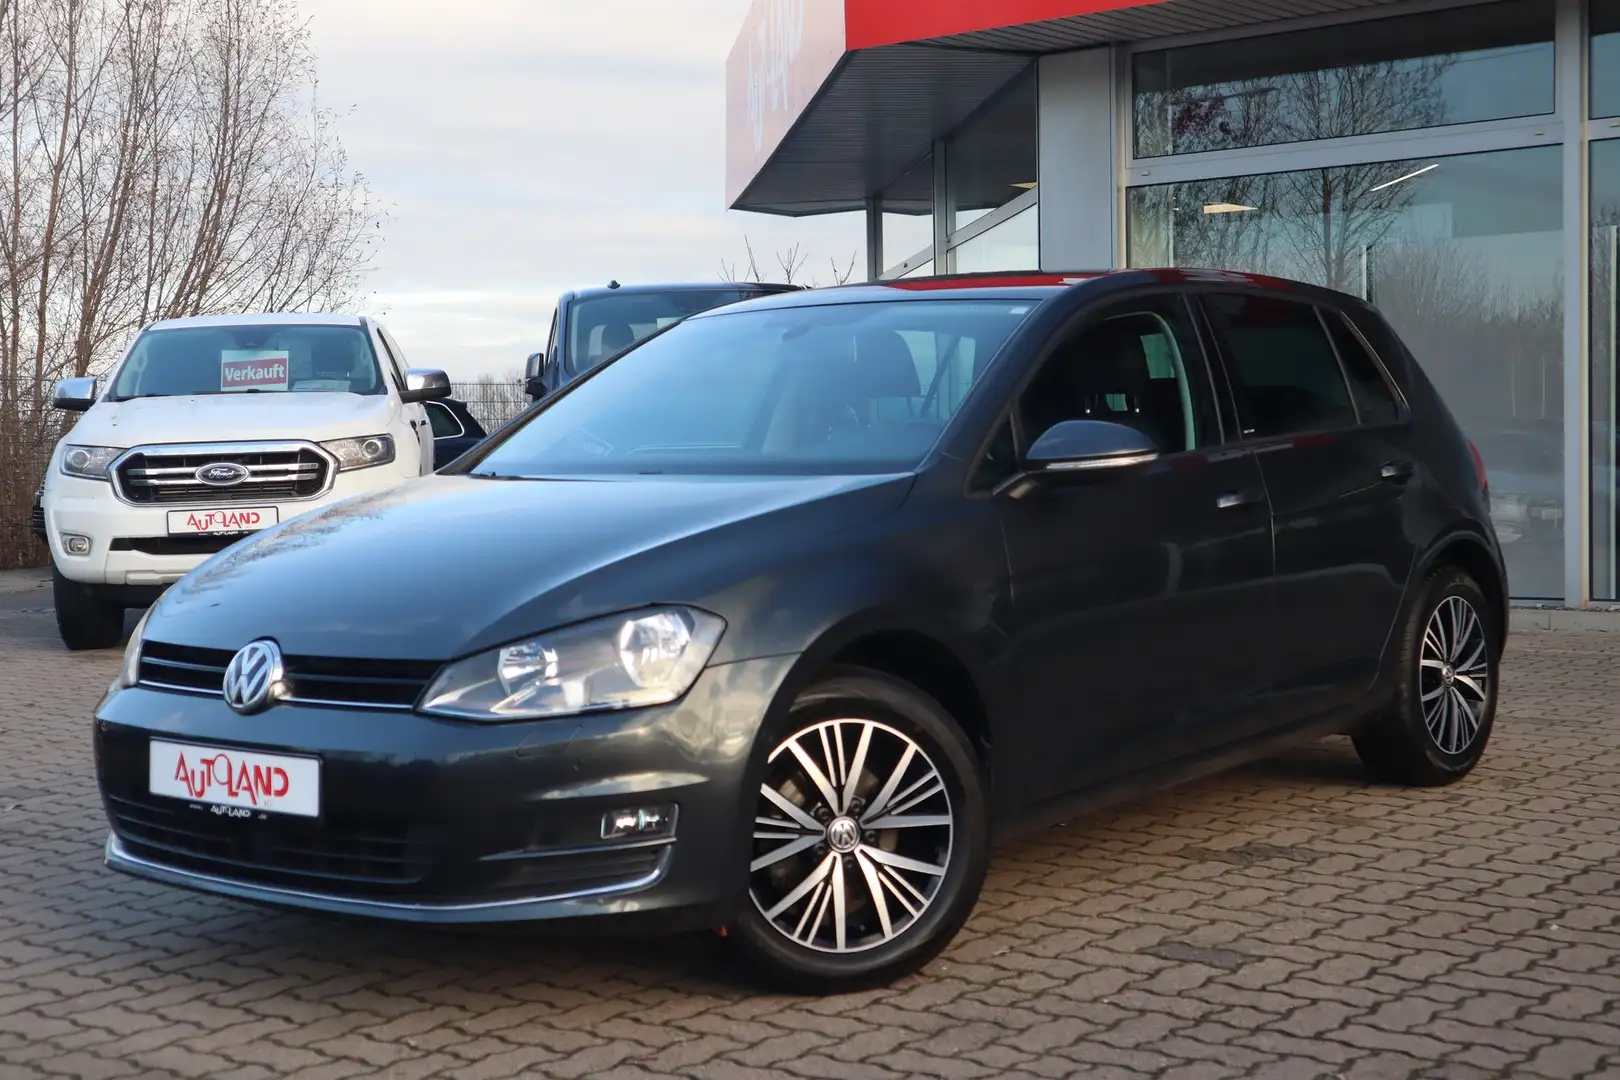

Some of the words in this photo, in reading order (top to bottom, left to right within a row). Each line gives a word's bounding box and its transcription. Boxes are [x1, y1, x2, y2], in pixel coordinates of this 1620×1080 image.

[224, 363, 285, 382] Verkauft
[208, 467, 236, 479] Ford
[187, 510, 260, 531] AUTOLAND
[223, 641, 275, 708] VW
[174, 750, 290, 806] AUTOLAND
[210, 804, 251, 819] AUTOLAND
